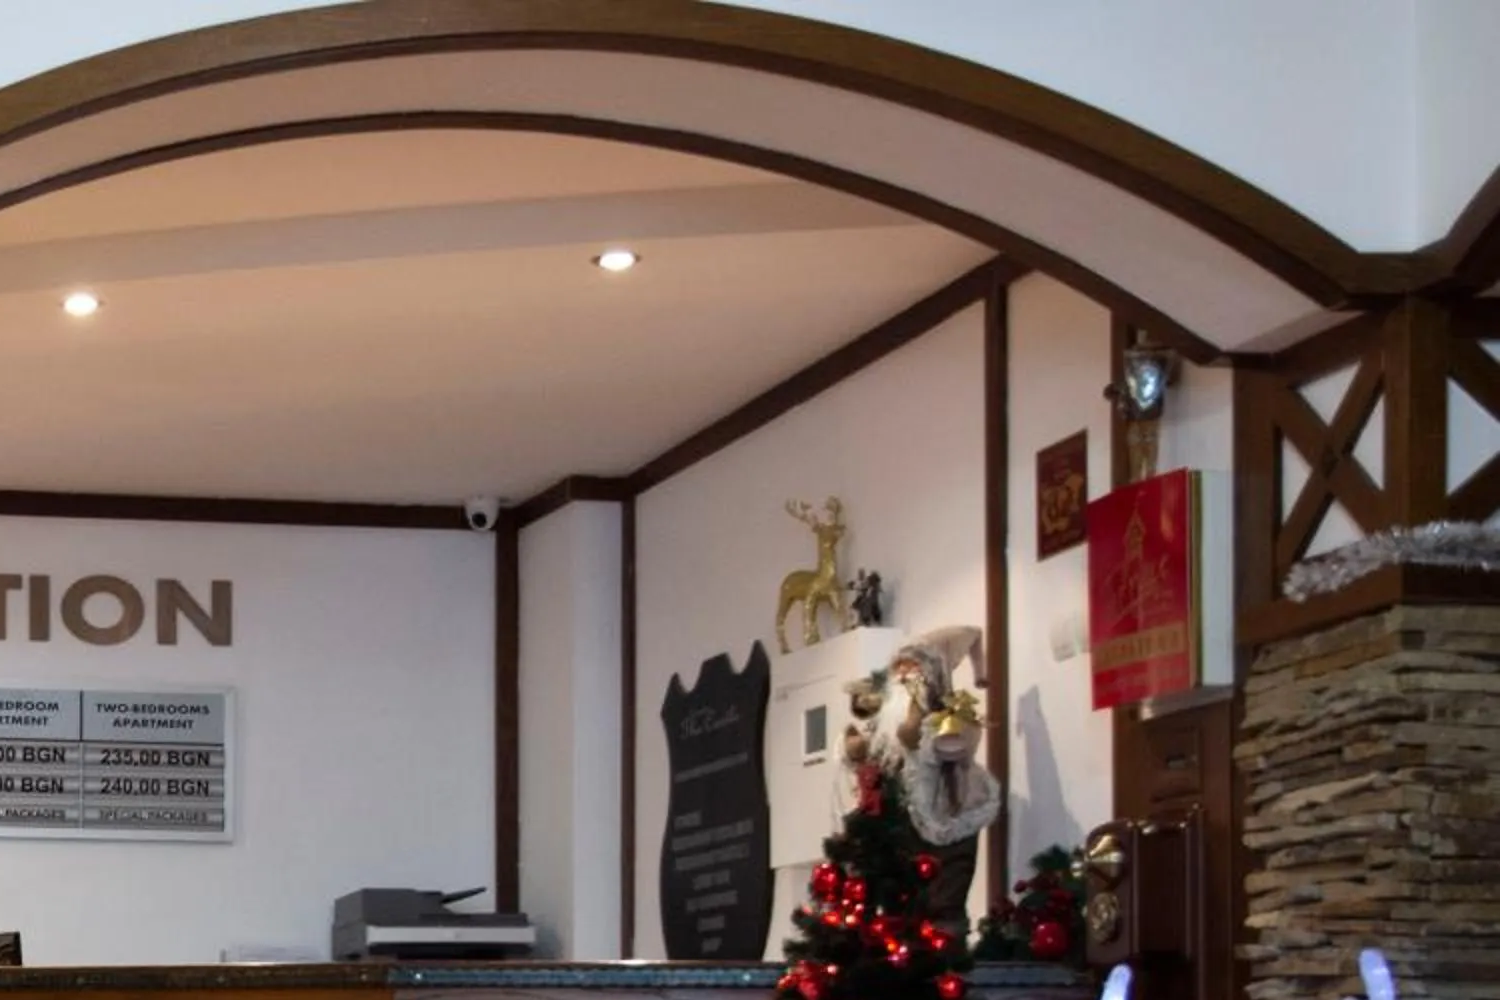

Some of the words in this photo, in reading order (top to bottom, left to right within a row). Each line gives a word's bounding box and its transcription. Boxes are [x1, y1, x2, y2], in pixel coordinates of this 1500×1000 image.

[97, 703, 210, 715] TWO-BEDROOMS
[113, 718, 195, 729] APARTMENT
[22, 747, 66, 763] BGN
[167, 750, 211, 767] BGN
[21, 776, 64, 793] BGN
[167, 779, 209, 797] BGN
